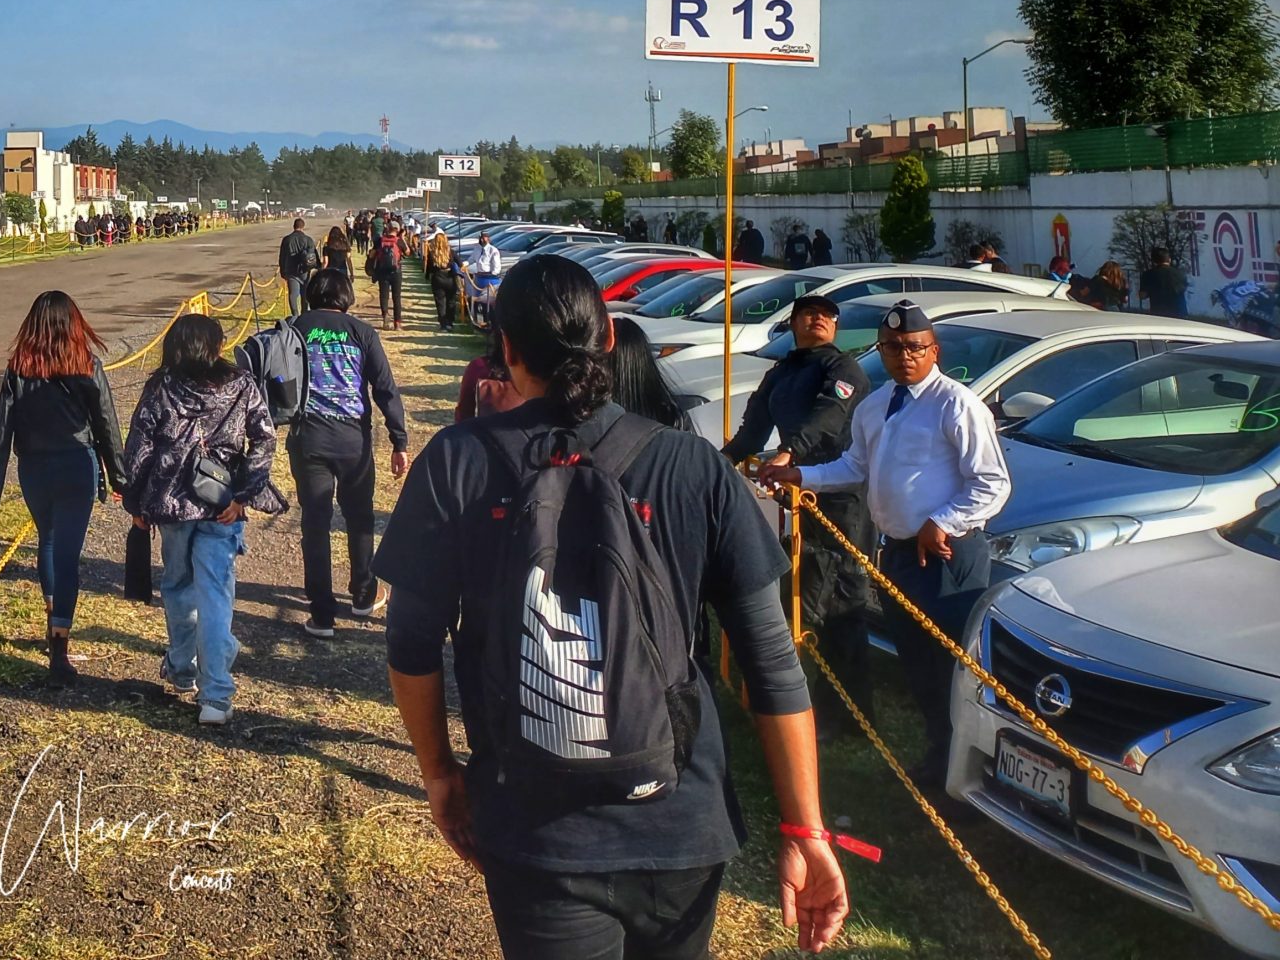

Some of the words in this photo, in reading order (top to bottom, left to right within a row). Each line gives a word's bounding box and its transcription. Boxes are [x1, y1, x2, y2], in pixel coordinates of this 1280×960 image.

[444, 159, 454, 170] R
[459, 159, 475, 171] 12
[998, 751, 1071, 803] NDG-77-3
[632, 780, 658, 796] NIKE
